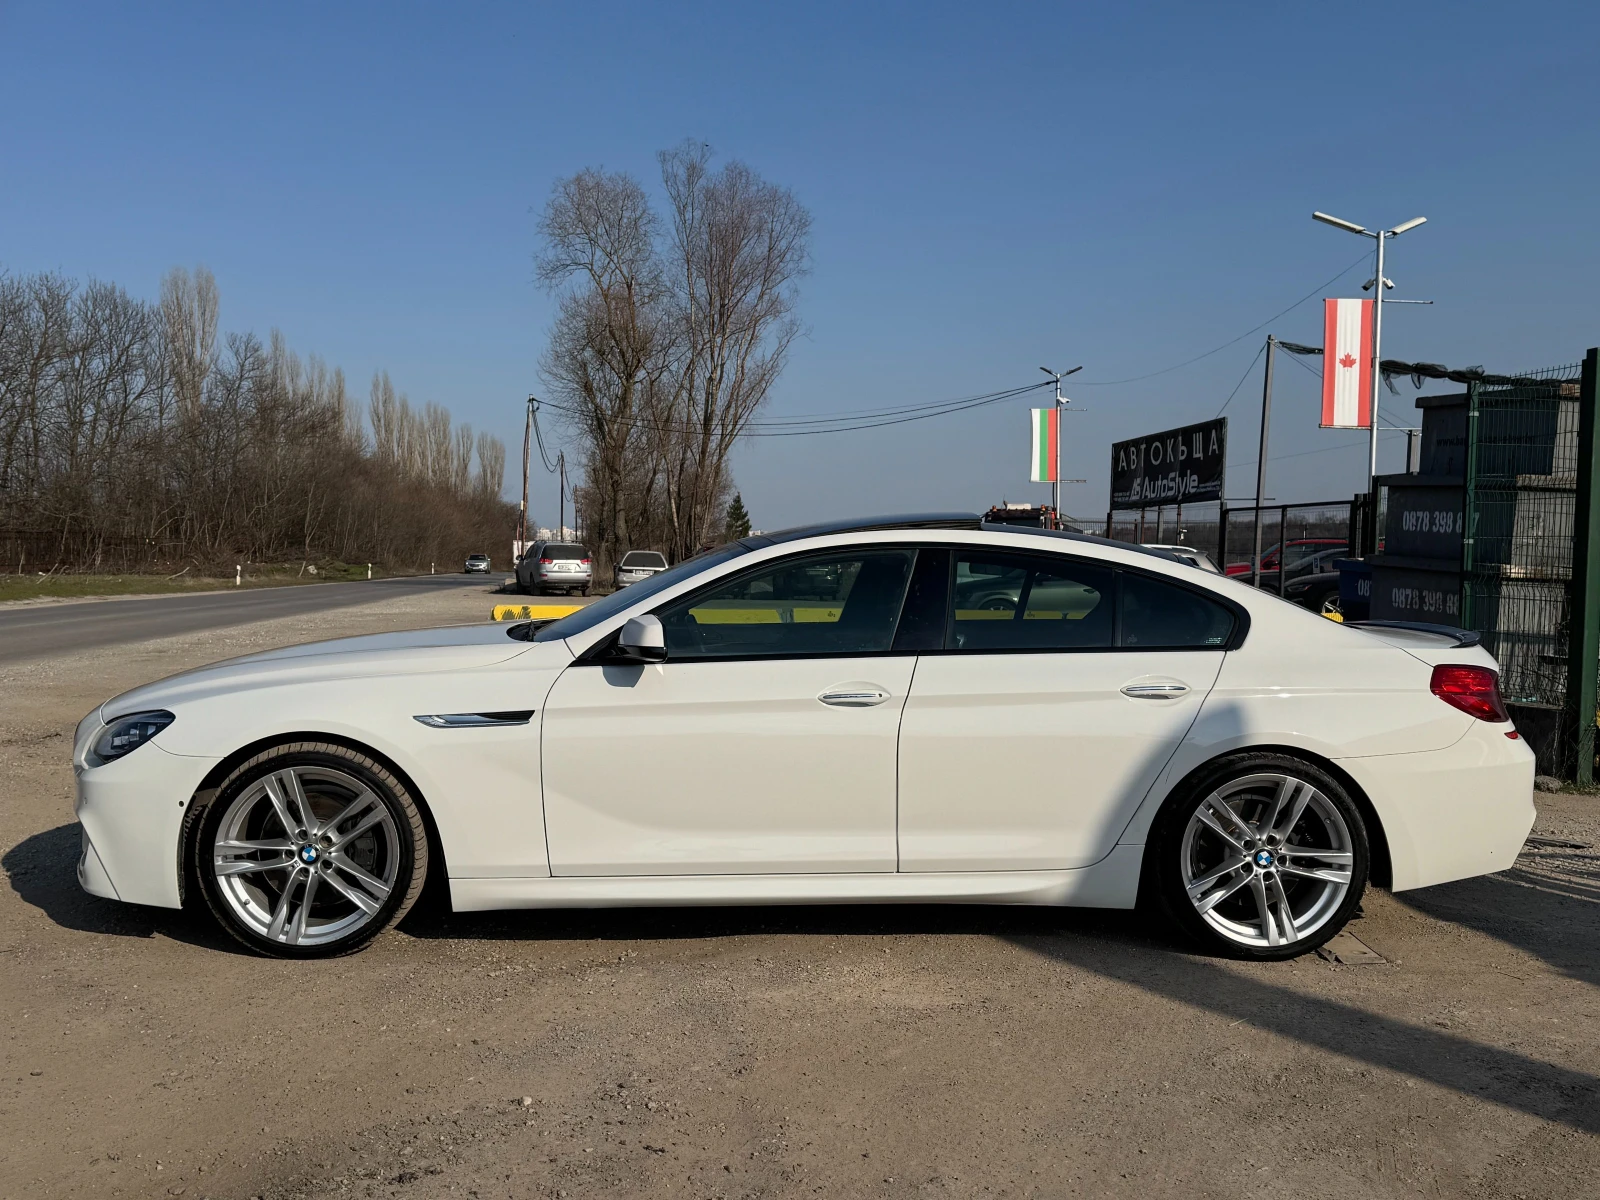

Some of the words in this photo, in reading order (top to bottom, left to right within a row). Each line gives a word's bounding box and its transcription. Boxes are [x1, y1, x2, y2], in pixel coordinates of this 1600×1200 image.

[1142, 469, 1199, 500] AutoStyle
[1402, 510, 1430, 532] 0878
[1432, 511, 1454, 533] 398
[1357, 579, 1372, 596] 08
[1392, 588, 1419, 609] 0878
[1422, 589, 1443, 613] 398
